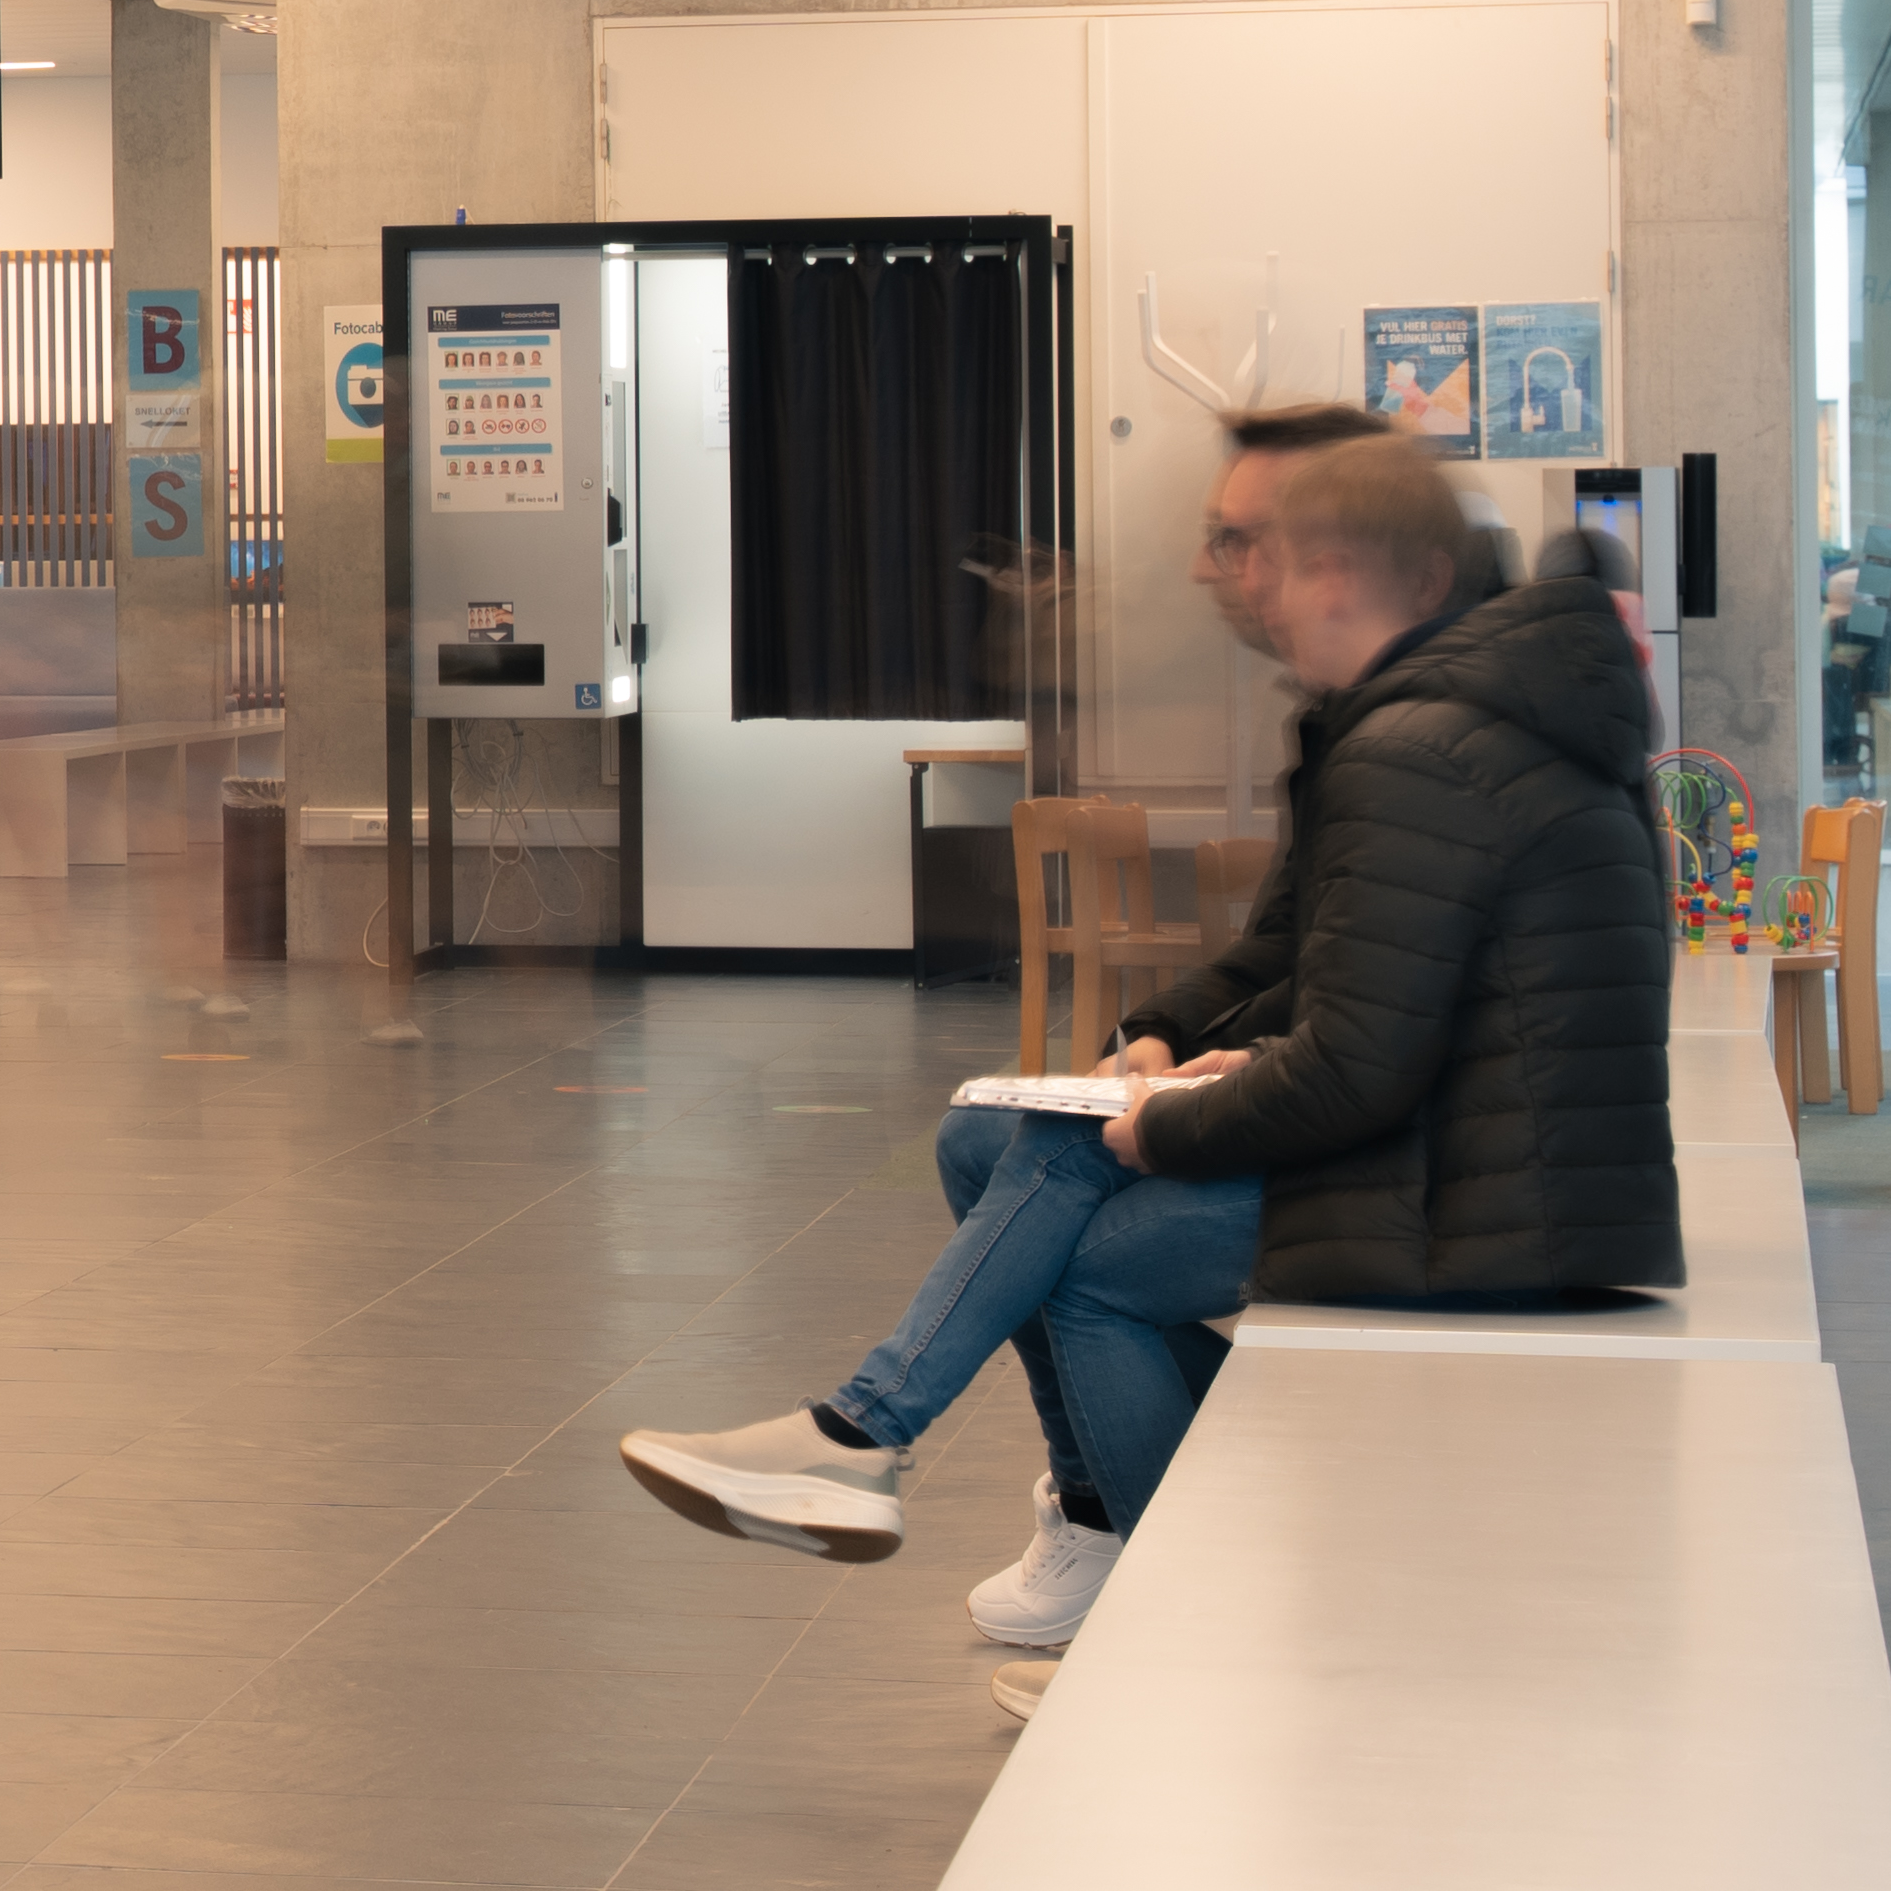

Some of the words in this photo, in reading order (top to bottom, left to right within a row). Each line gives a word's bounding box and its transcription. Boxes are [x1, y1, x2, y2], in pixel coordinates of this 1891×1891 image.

[1380, 322, 1400, 332] VUL
[1404, 321, 1427, 331] HIER
[1430, 320, 1468, 331] GRATIS
[1496, 315, 1536, 326] DORST?
[142, 306, 185, 375] B
[1376, 333, 1387, 345] JE
[1390, 333, 1442, 344] DRINKBUS
[1446, 332, 1468, 343] MET
[1429, 345, 1468, 355] WATER.
[135, 407, 191, 416] SNELLOKET
[144, 471, 188, 541] S
